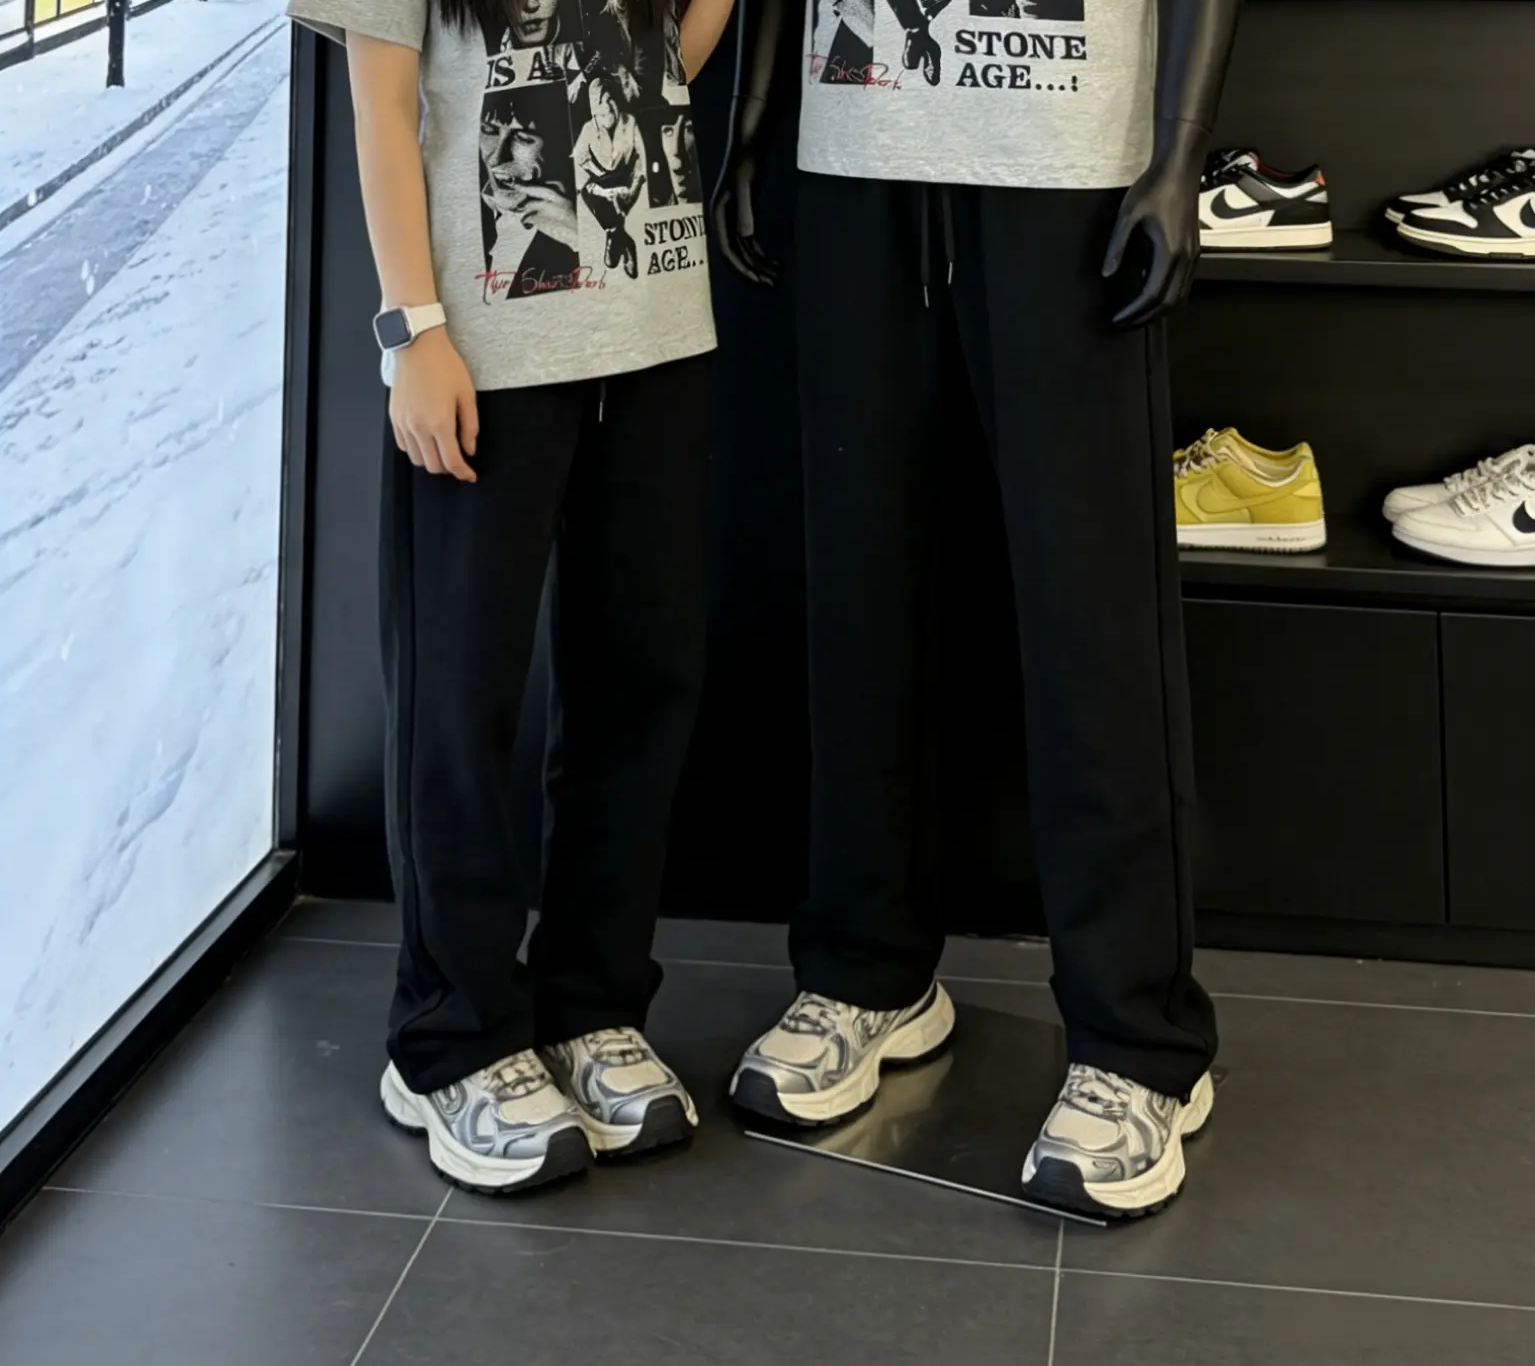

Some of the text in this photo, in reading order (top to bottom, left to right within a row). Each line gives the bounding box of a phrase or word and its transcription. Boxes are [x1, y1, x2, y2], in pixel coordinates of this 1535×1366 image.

[954, 29, 1087, 60] STONE
[485, 51, 560, 89] IS A
